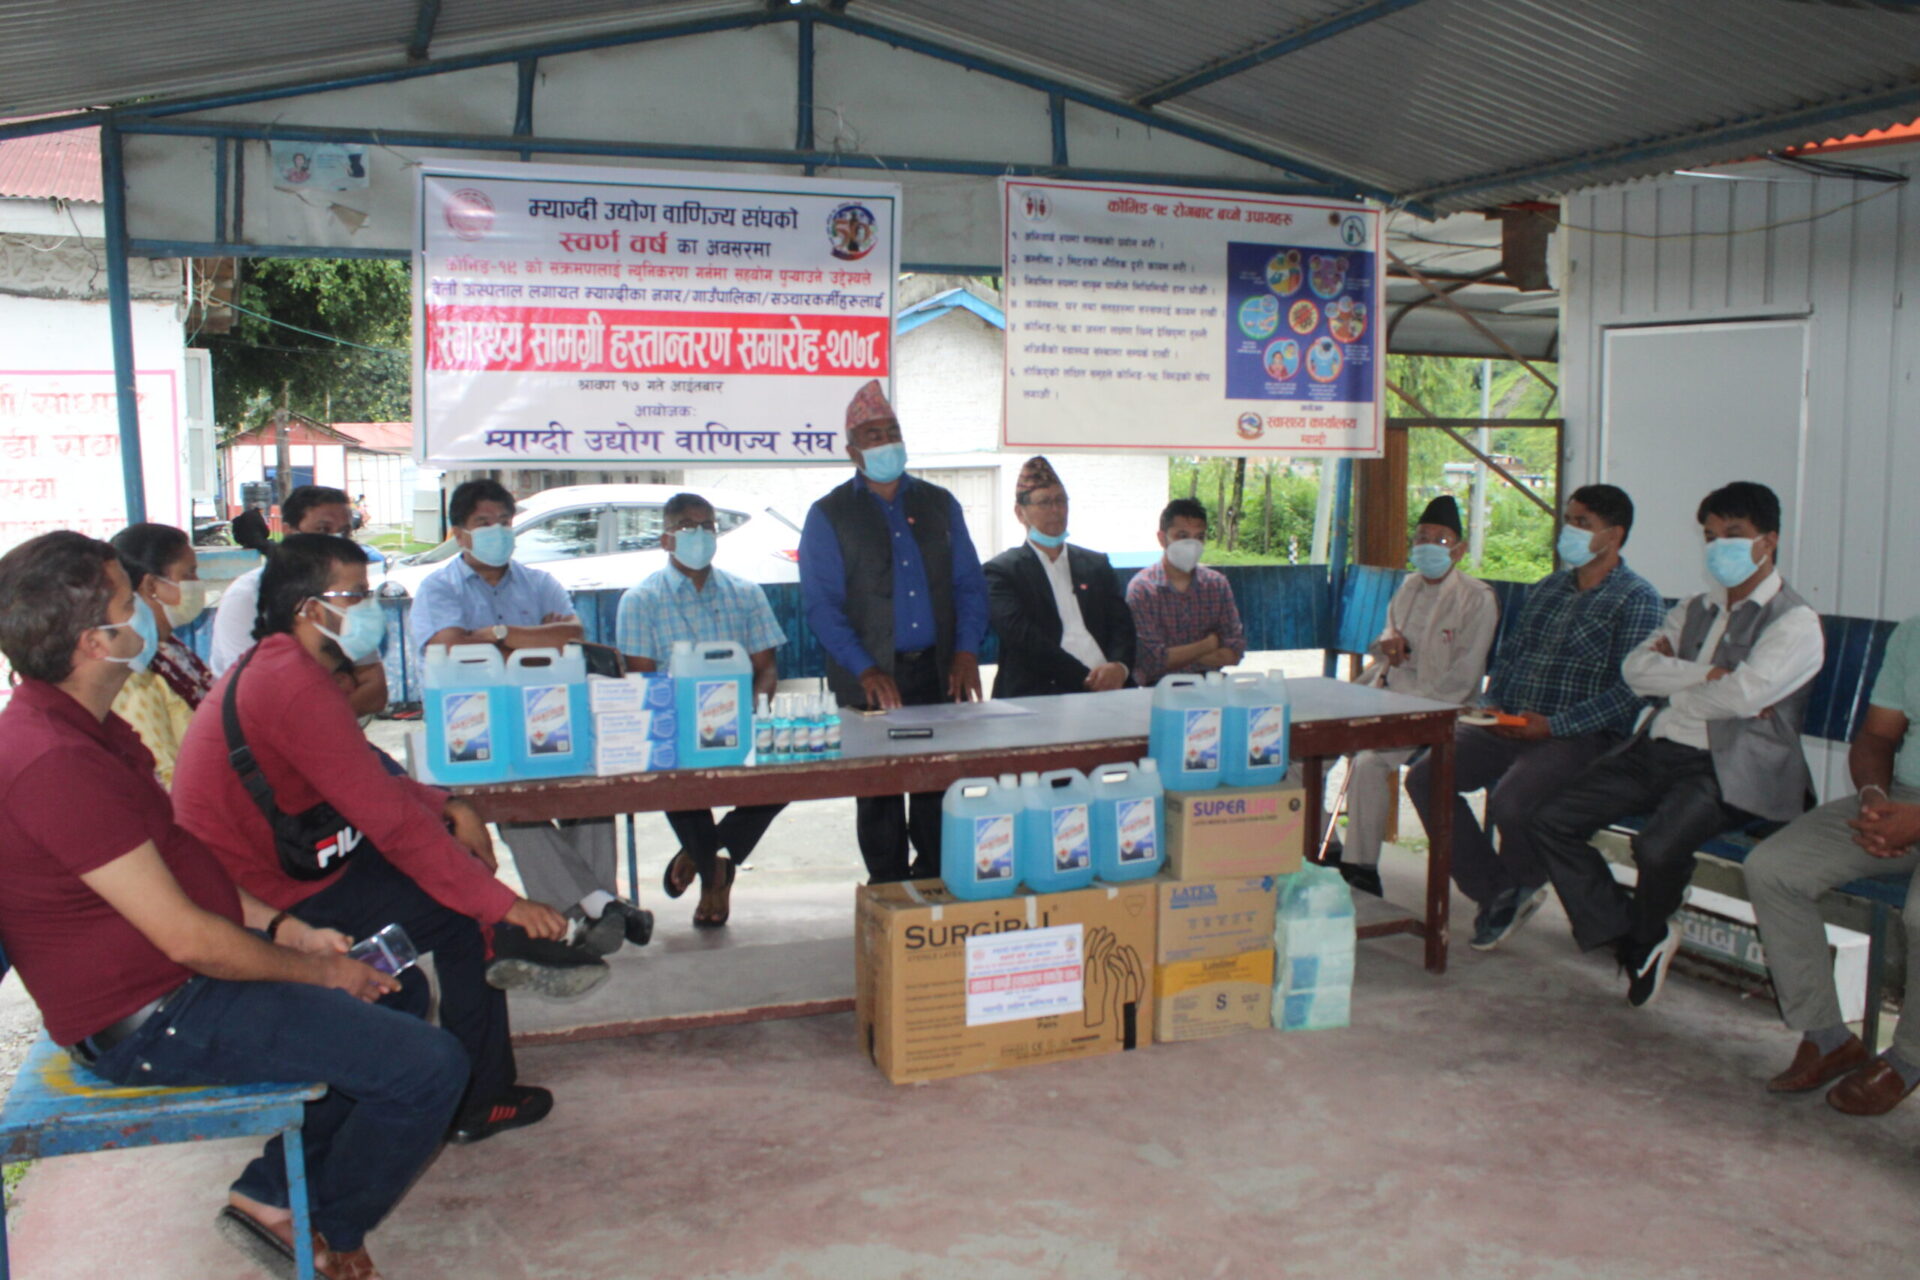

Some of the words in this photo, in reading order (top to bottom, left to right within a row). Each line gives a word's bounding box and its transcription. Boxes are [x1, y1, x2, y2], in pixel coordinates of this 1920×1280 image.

[528, 197, 598, 220] म्याग्दी
[604, 199, 656, 222] उद्योग
[663, 201, 736, 227] वाणिज्य
[742, 206, 798, 229] संघको
[559, 230, 620, 253] स्वर्ण
[630, 231, 668, 255] वर्ष
[677, 238, 698, 255] का
[706, 240, 771, 259] अवसरमा
[525, 258, 543, 274] को
[735, 266, 773, 283] सहयोग
[462, 282, 523, 298] अस्पताल
[529, 285, 578, 300] लगायत
[585, 283, 647, 303] म्याग्दीका
[436, 321, 524, 365] स्वास्थ्य
[529, 311, 605, 370] सामग्री
[610, 325, 733, 369] हस्तान्तरण
[737, 316, 880, 372] समारोह-२०७८
[622, 380, 639, 391] १७
[647, 377, 666, 392] गते
[485, 421, 573, 454] म्याग्दी
[584, 422, 664, 454] उद्योग
[675, 421, 780, 454] वाणिज्य
[792, 423, 837, 455] संघ
[1172, 885, 1216, 898] LATEX
[1216, 993, 1227, 1010] S
